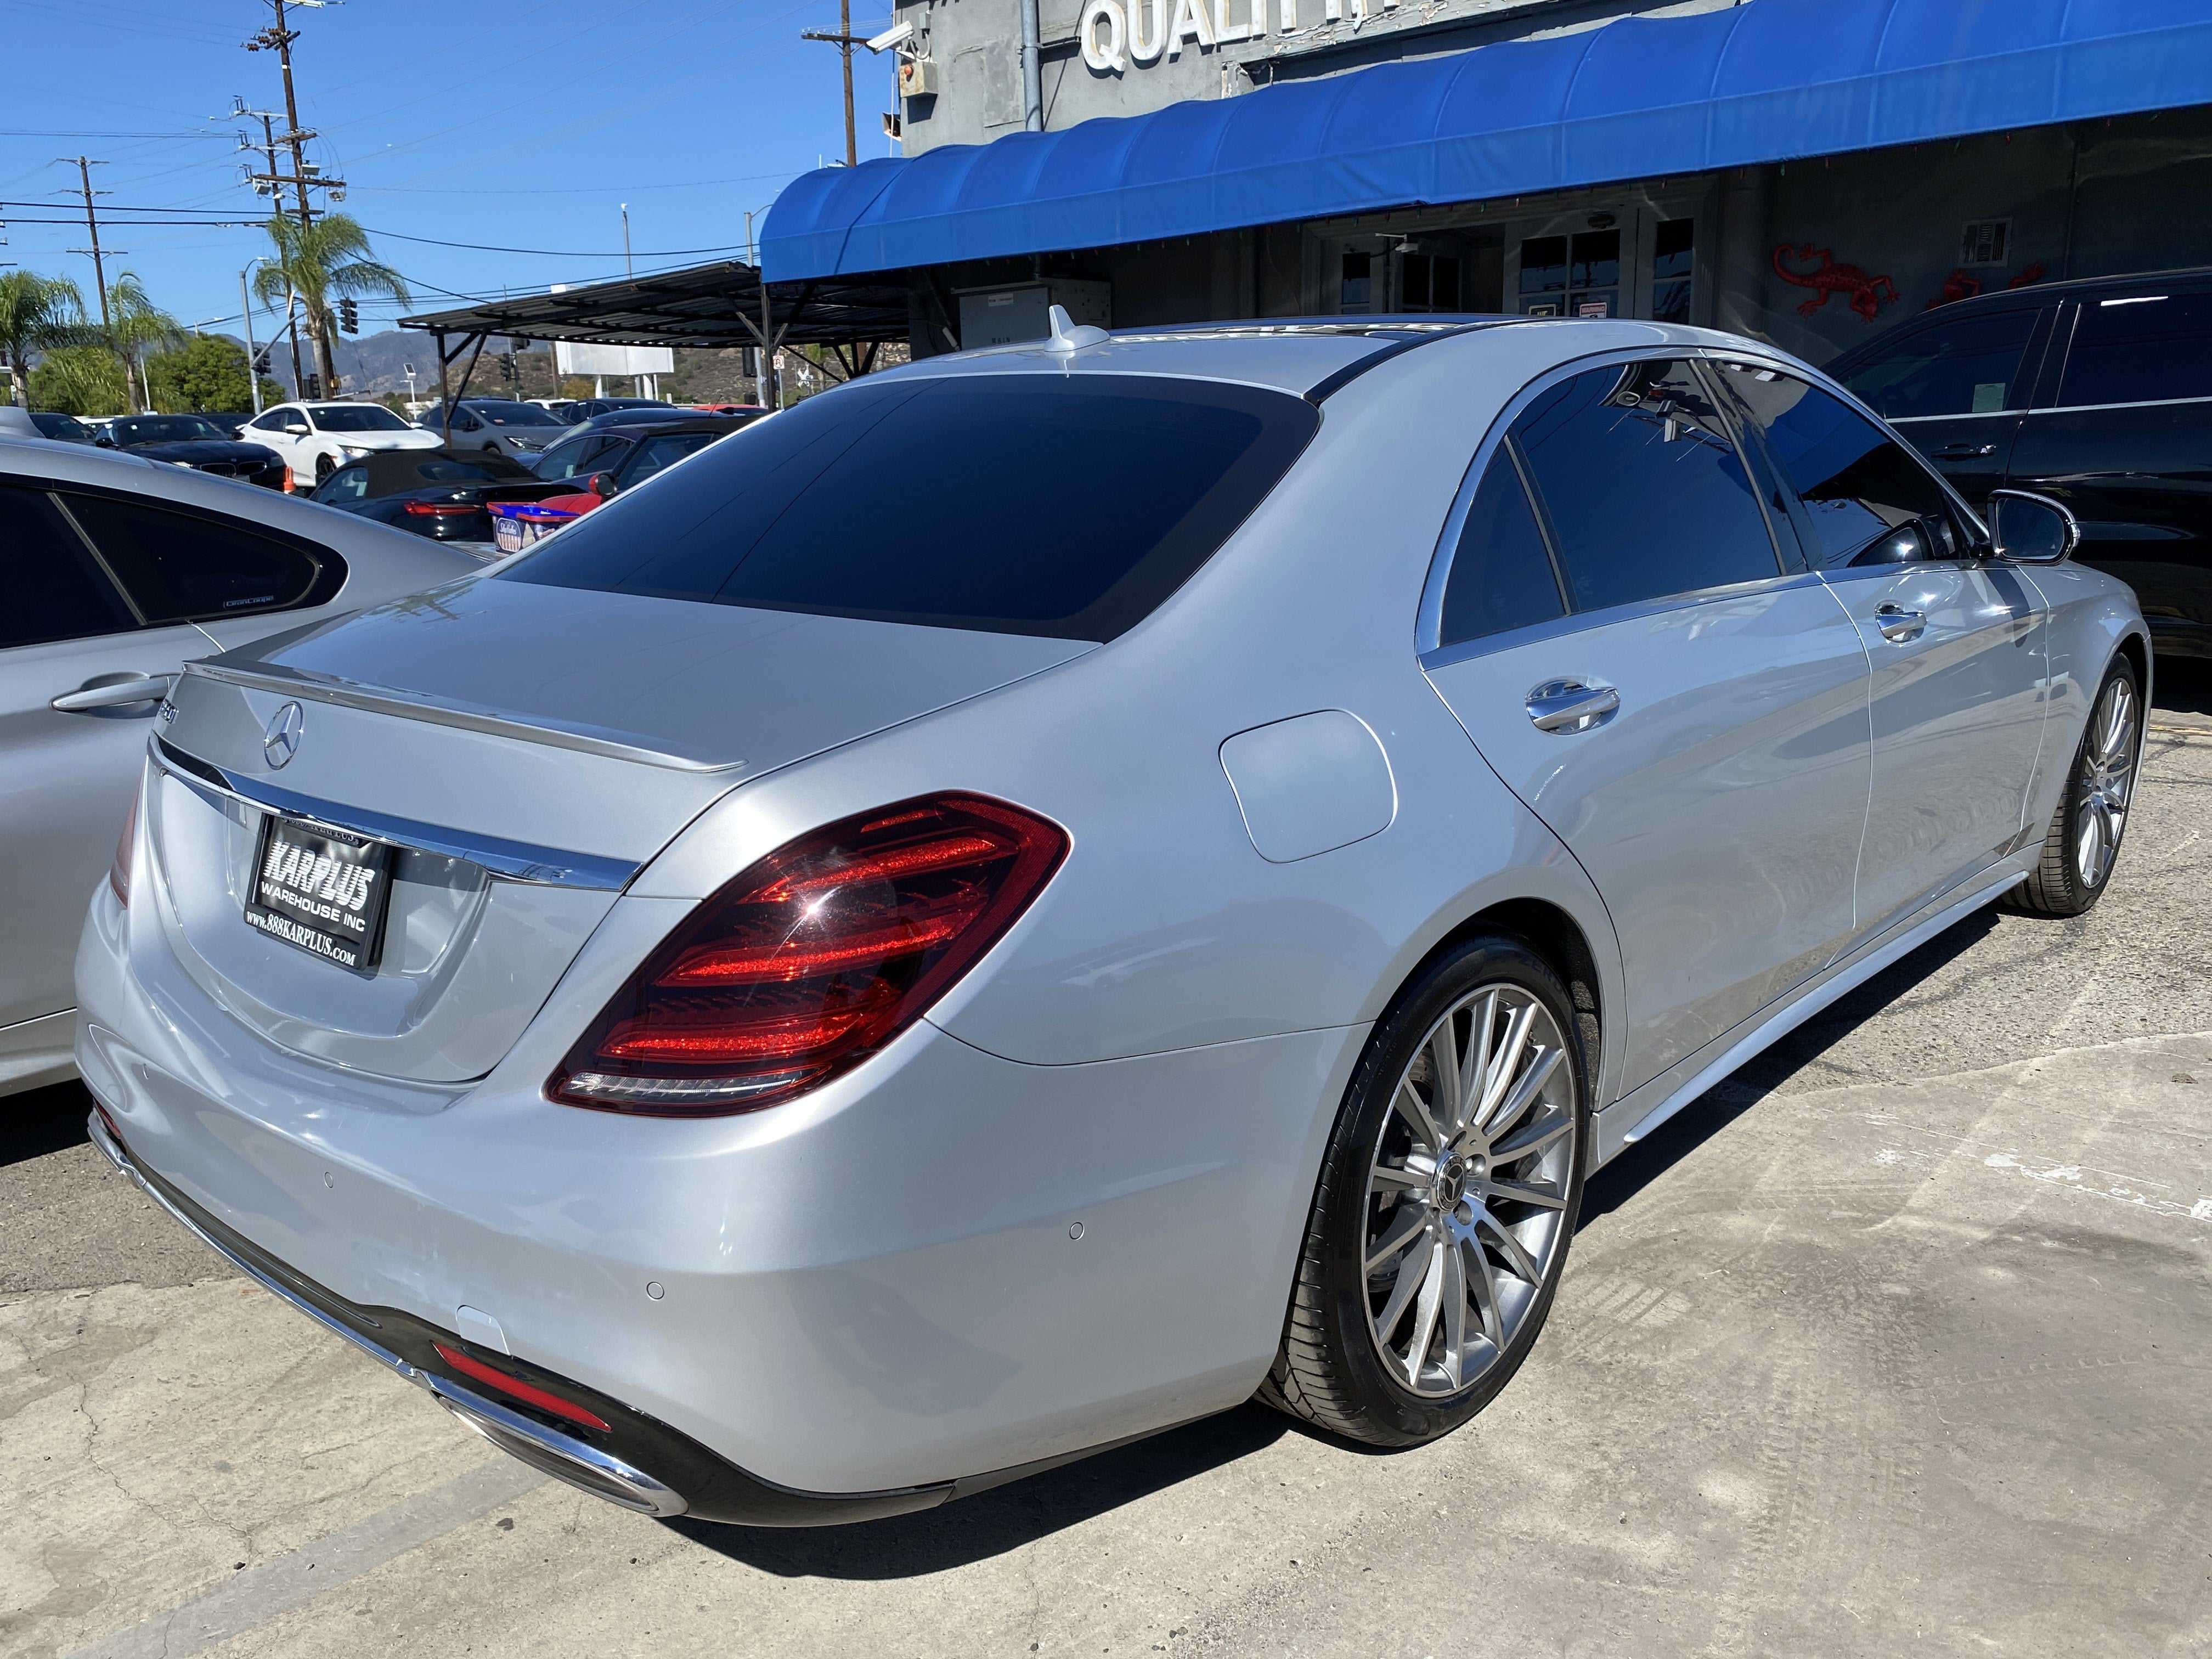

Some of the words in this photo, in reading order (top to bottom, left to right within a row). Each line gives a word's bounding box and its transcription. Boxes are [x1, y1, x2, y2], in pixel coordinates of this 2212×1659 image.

[263, 840, 375, 911] KARPLUS
[261, 881, 341, 922] WAREHOUSE
[343, 913, 365, 932] INC
